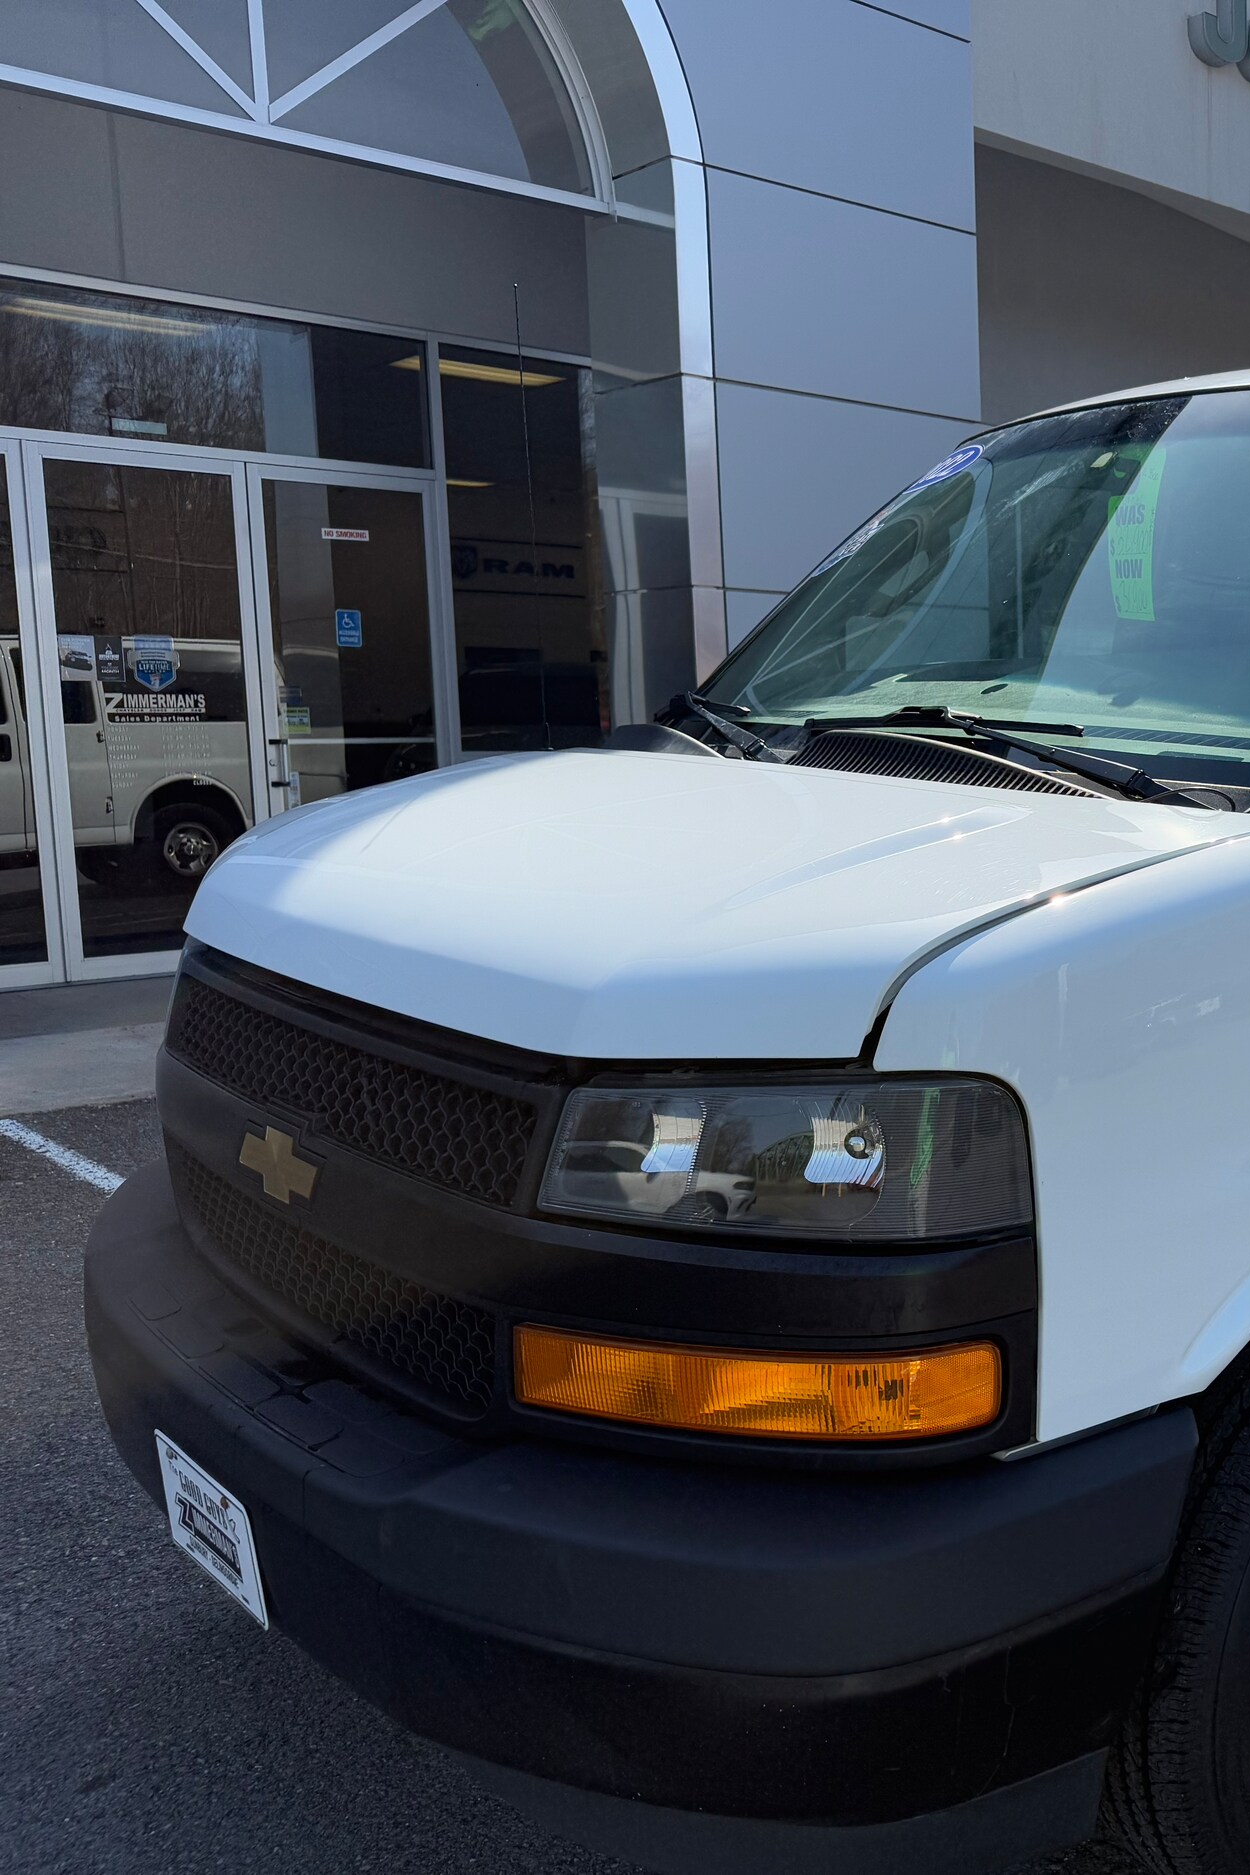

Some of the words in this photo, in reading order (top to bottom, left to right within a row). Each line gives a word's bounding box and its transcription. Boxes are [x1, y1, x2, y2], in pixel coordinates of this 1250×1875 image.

[1115, 504, 1145, 526] WAS
[324, 530, 334, 538] NO
[335, 530, 367, 539] SMOKING
[483, 558, 575, 579] RAM
[1115, 559, 1143, 579] NOW
[104, 693, 206, 713] ZIMMERMAN'S
[144, 715, 200, 723] Department
[179, 1471, 203, 1508] GOOD
[203, 1492, 228, 1531] GUYS
